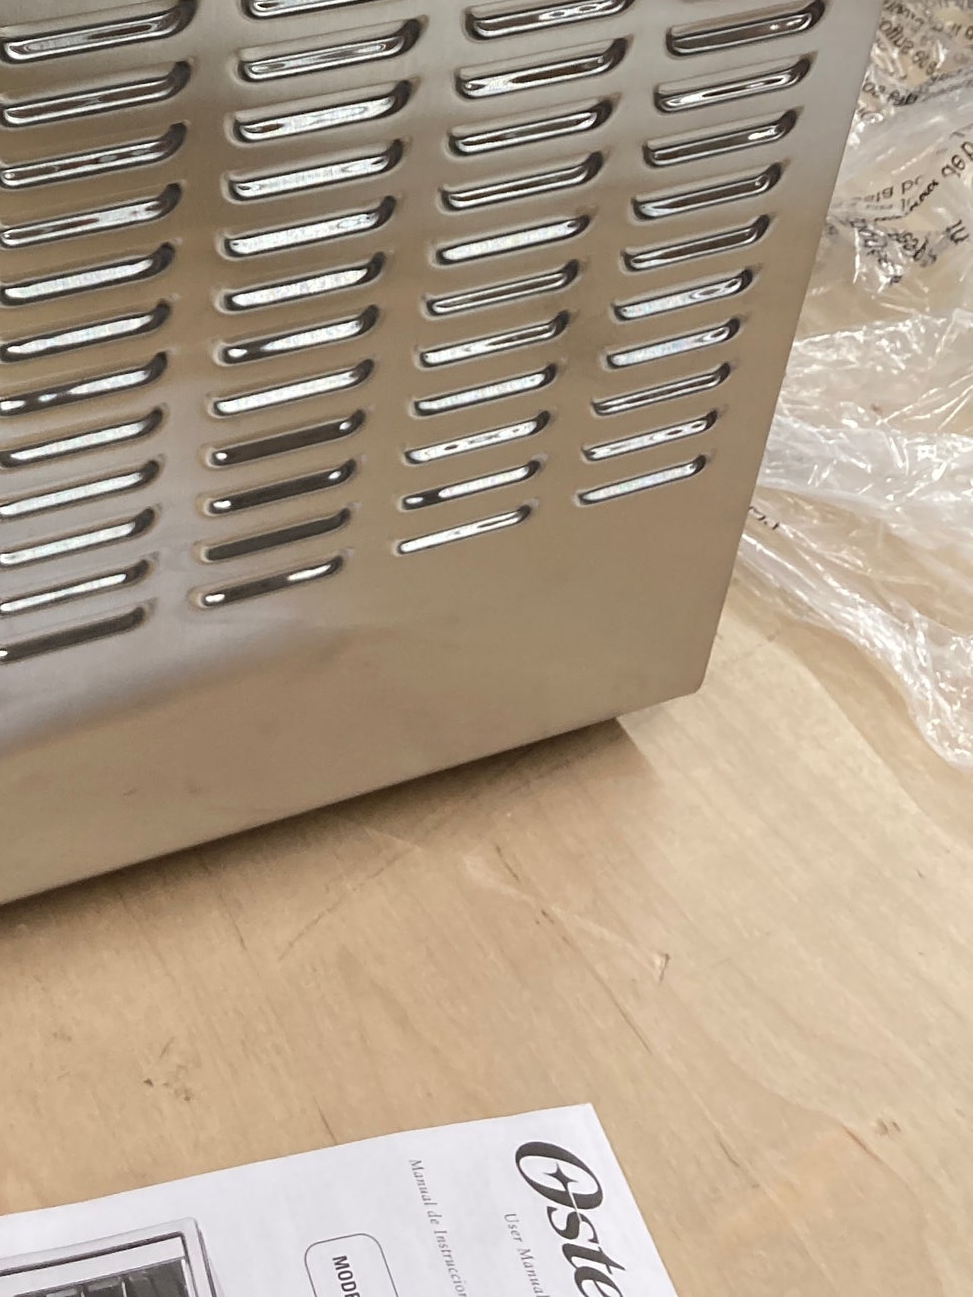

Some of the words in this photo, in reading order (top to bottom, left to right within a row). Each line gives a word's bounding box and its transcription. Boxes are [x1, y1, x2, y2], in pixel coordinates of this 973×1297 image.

[409, 1158, 432, 1206] Manual
[427, 1209, 439, 1225] de
[504, 1212, 523, 1244] User
